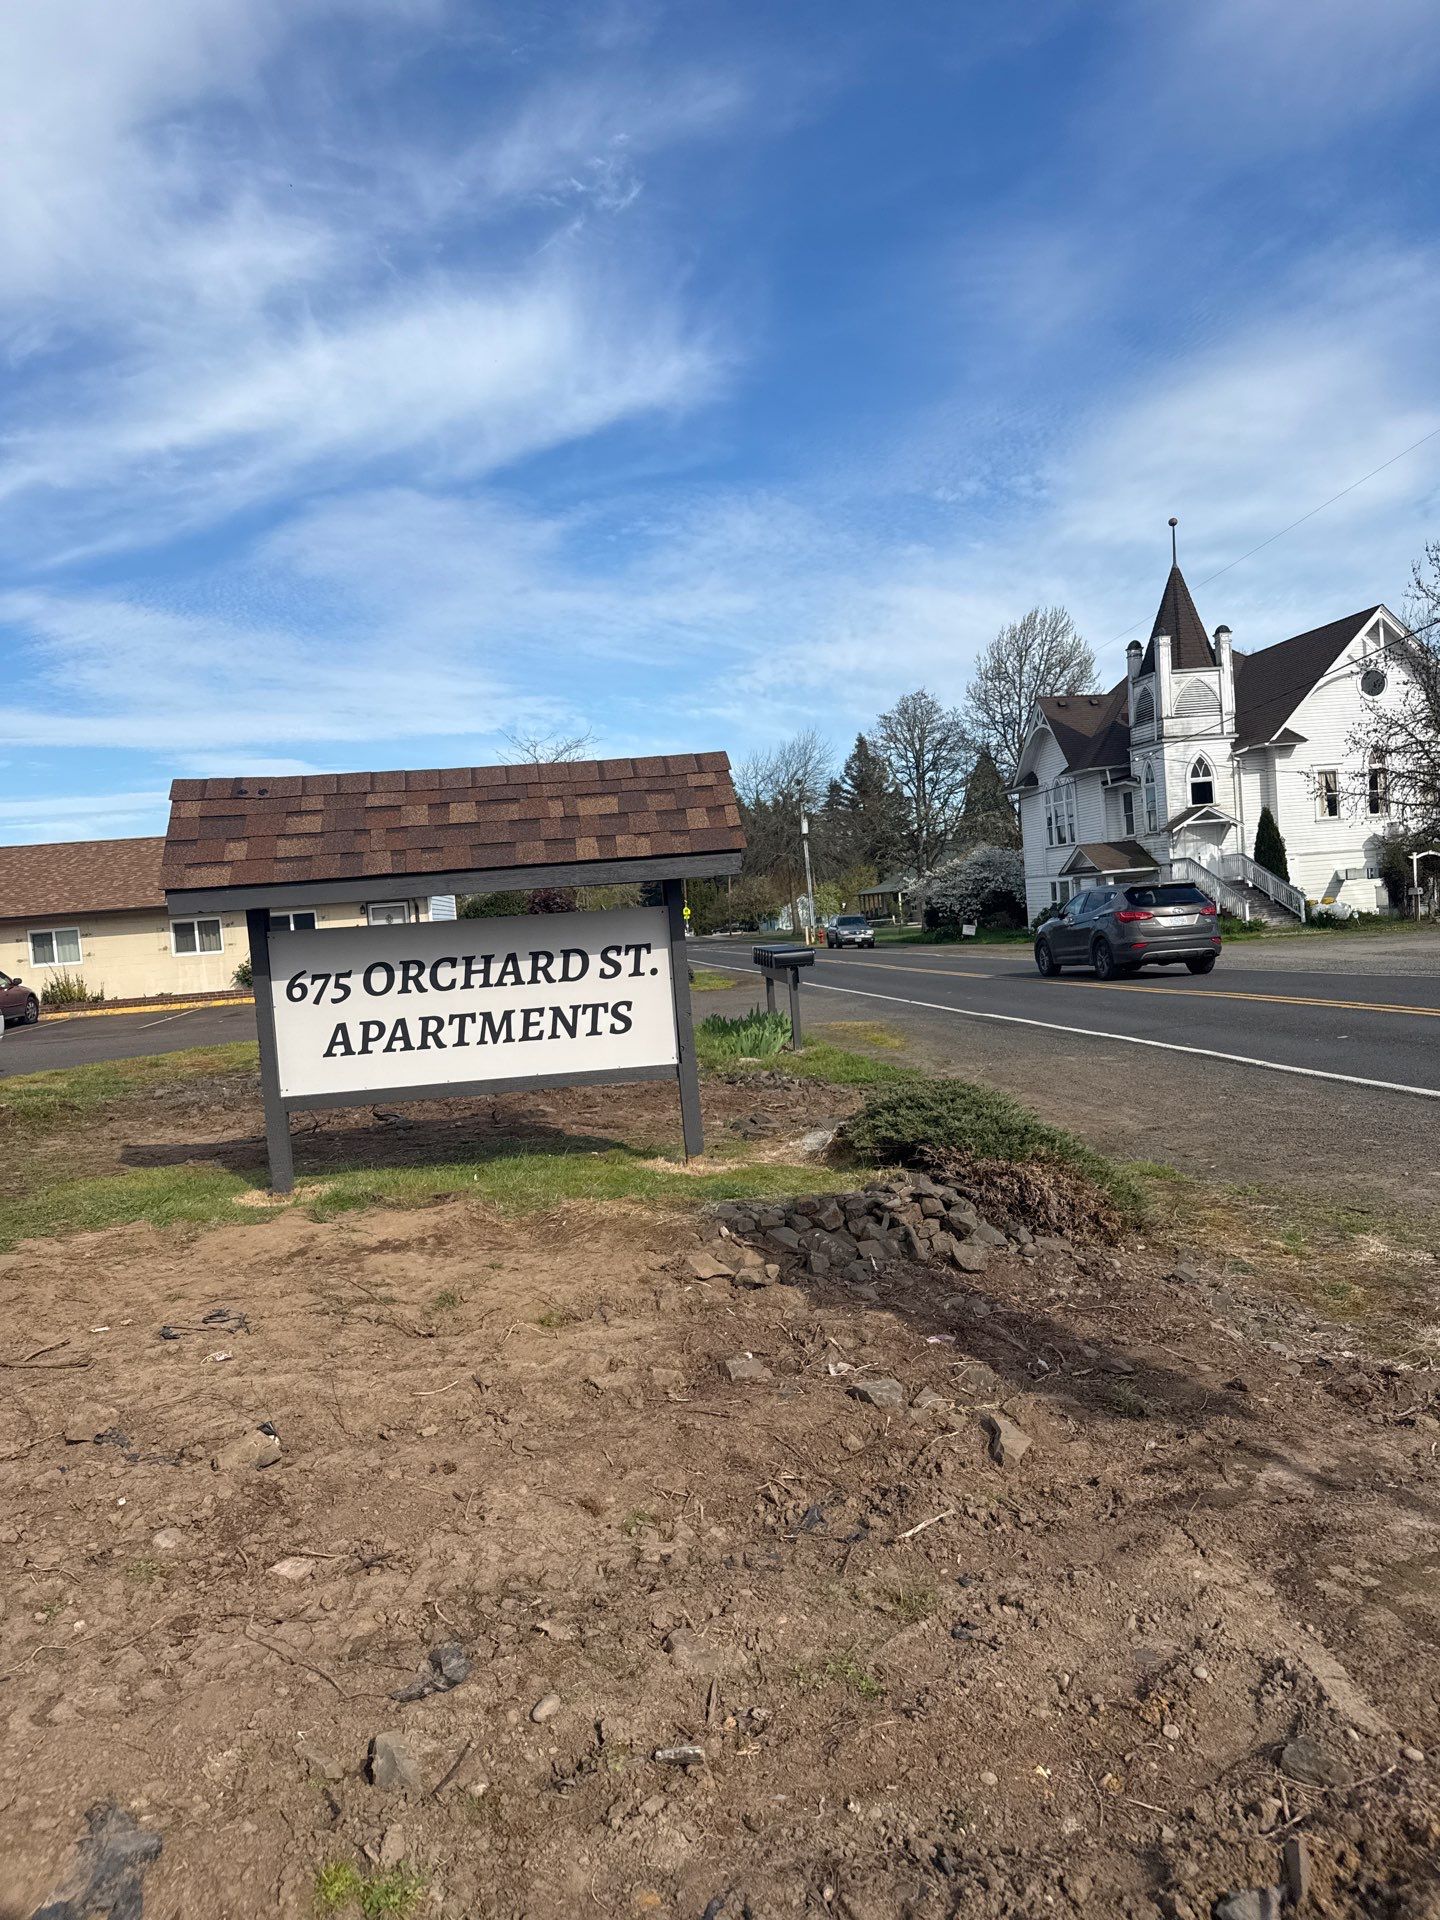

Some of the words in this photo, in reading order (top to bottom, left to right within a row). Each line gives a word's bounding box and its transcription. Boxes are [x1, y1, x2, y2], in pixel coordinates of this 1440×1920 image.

[286, 969, 353, 1005] 675
[362, 947, 590, 997] ORCHARD
[599, 942, 659, 980] ST.
[322, 1000, 633, 1058] APARTMENTS
